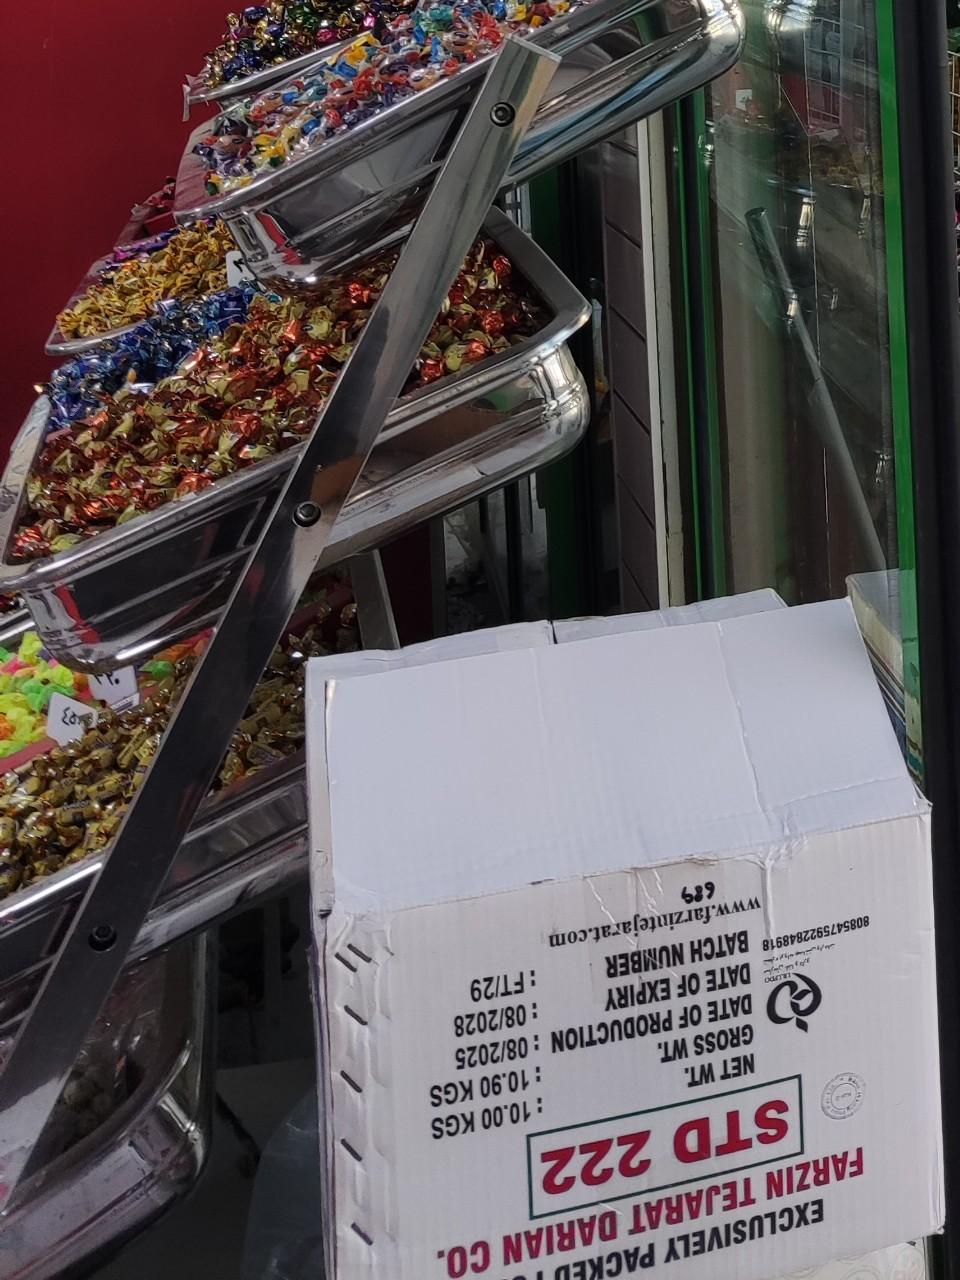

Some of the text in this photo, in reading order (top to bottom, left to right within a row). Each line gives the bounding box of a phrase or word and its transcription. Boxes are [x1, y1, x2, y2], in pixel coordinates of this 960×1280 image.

[548, 896, 762, 948] www.farzintejarat.com
[762, 915, 870, 952] 8085475922848918
[604, 942, 685, 979] NUMBER
[689, 929, 750, 964] BATCH
[469, 971, 525, 1003] FT/29
[676, 972, 701, 999] OF
[705, 962, 752, 993] DATE
[604, 977, 672, 1012] EXPIRY
[706, 993, 753, 1023] DATE
[453, 1003, 527, 1038] 08/2028
[550, 1009, 673, 1054] PRODUCTION
[678, 1004, 703, 1030] OF
[454, 1036, 529, 1071] 08/2025
[657, 1037, 689, 1064] WT.
[692, 1023, 754, 1057] GROSS
[684, 1062, 716, 1089] WT.
[719, 1052, 755, 1081] NET
[429, 1079, 474, 1108] KGS
[479, 1069, 530, 1099] 10.90
[430, 1111, 475, 1140] KGS
[481, 1100, 531, 1130] 10.00
[540, 1099, 790, 1195] STD 222
[436, 1146, 864, 1280] FARZIN TEJARAT DARIAN CO.
[554, 1198, 825, 1280] EXCLUSIVELY PACKED
